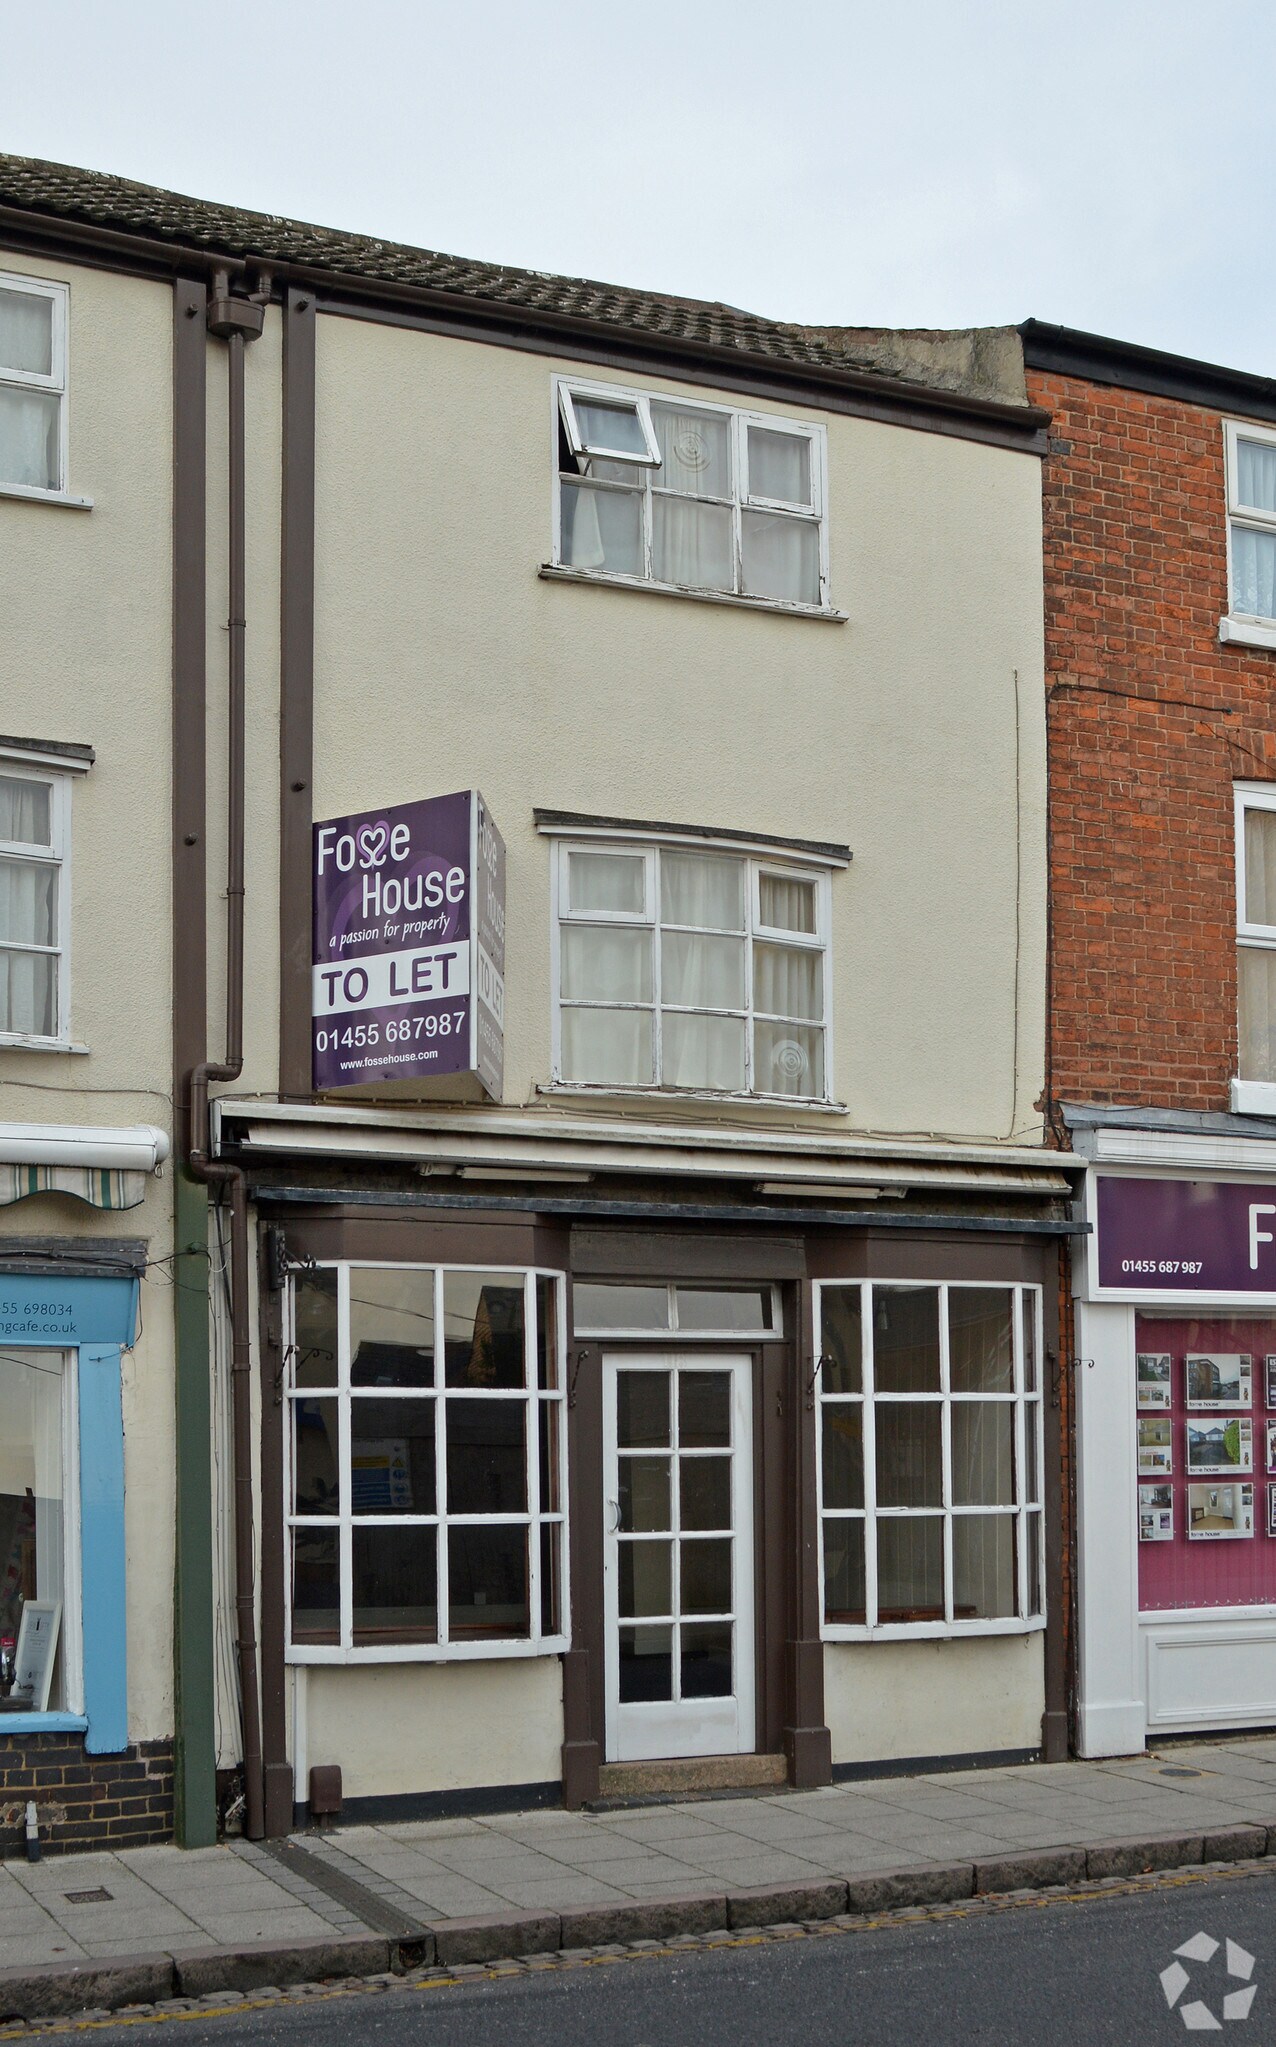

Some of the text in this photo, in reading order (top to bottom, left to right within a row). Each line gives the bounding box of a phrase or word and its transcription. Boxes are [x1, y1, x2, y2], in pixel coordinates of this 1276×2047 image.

[363, 867, 465, 918] House
[329, 911, 451, 951] a passion for property
[320, 952, 458, 1007] TO LET
[316, 1023, 380, 1052] 01455
[385, 1011, 466, 1042] 687987
[340, 1050, 438, 1070] www.fossehouse.com
[1249, 1203, 1276, 1270] F
[1121, 1259, 1203, 1274] 01455 687 987
[0, 1302, 73, 1316] 55 698034
